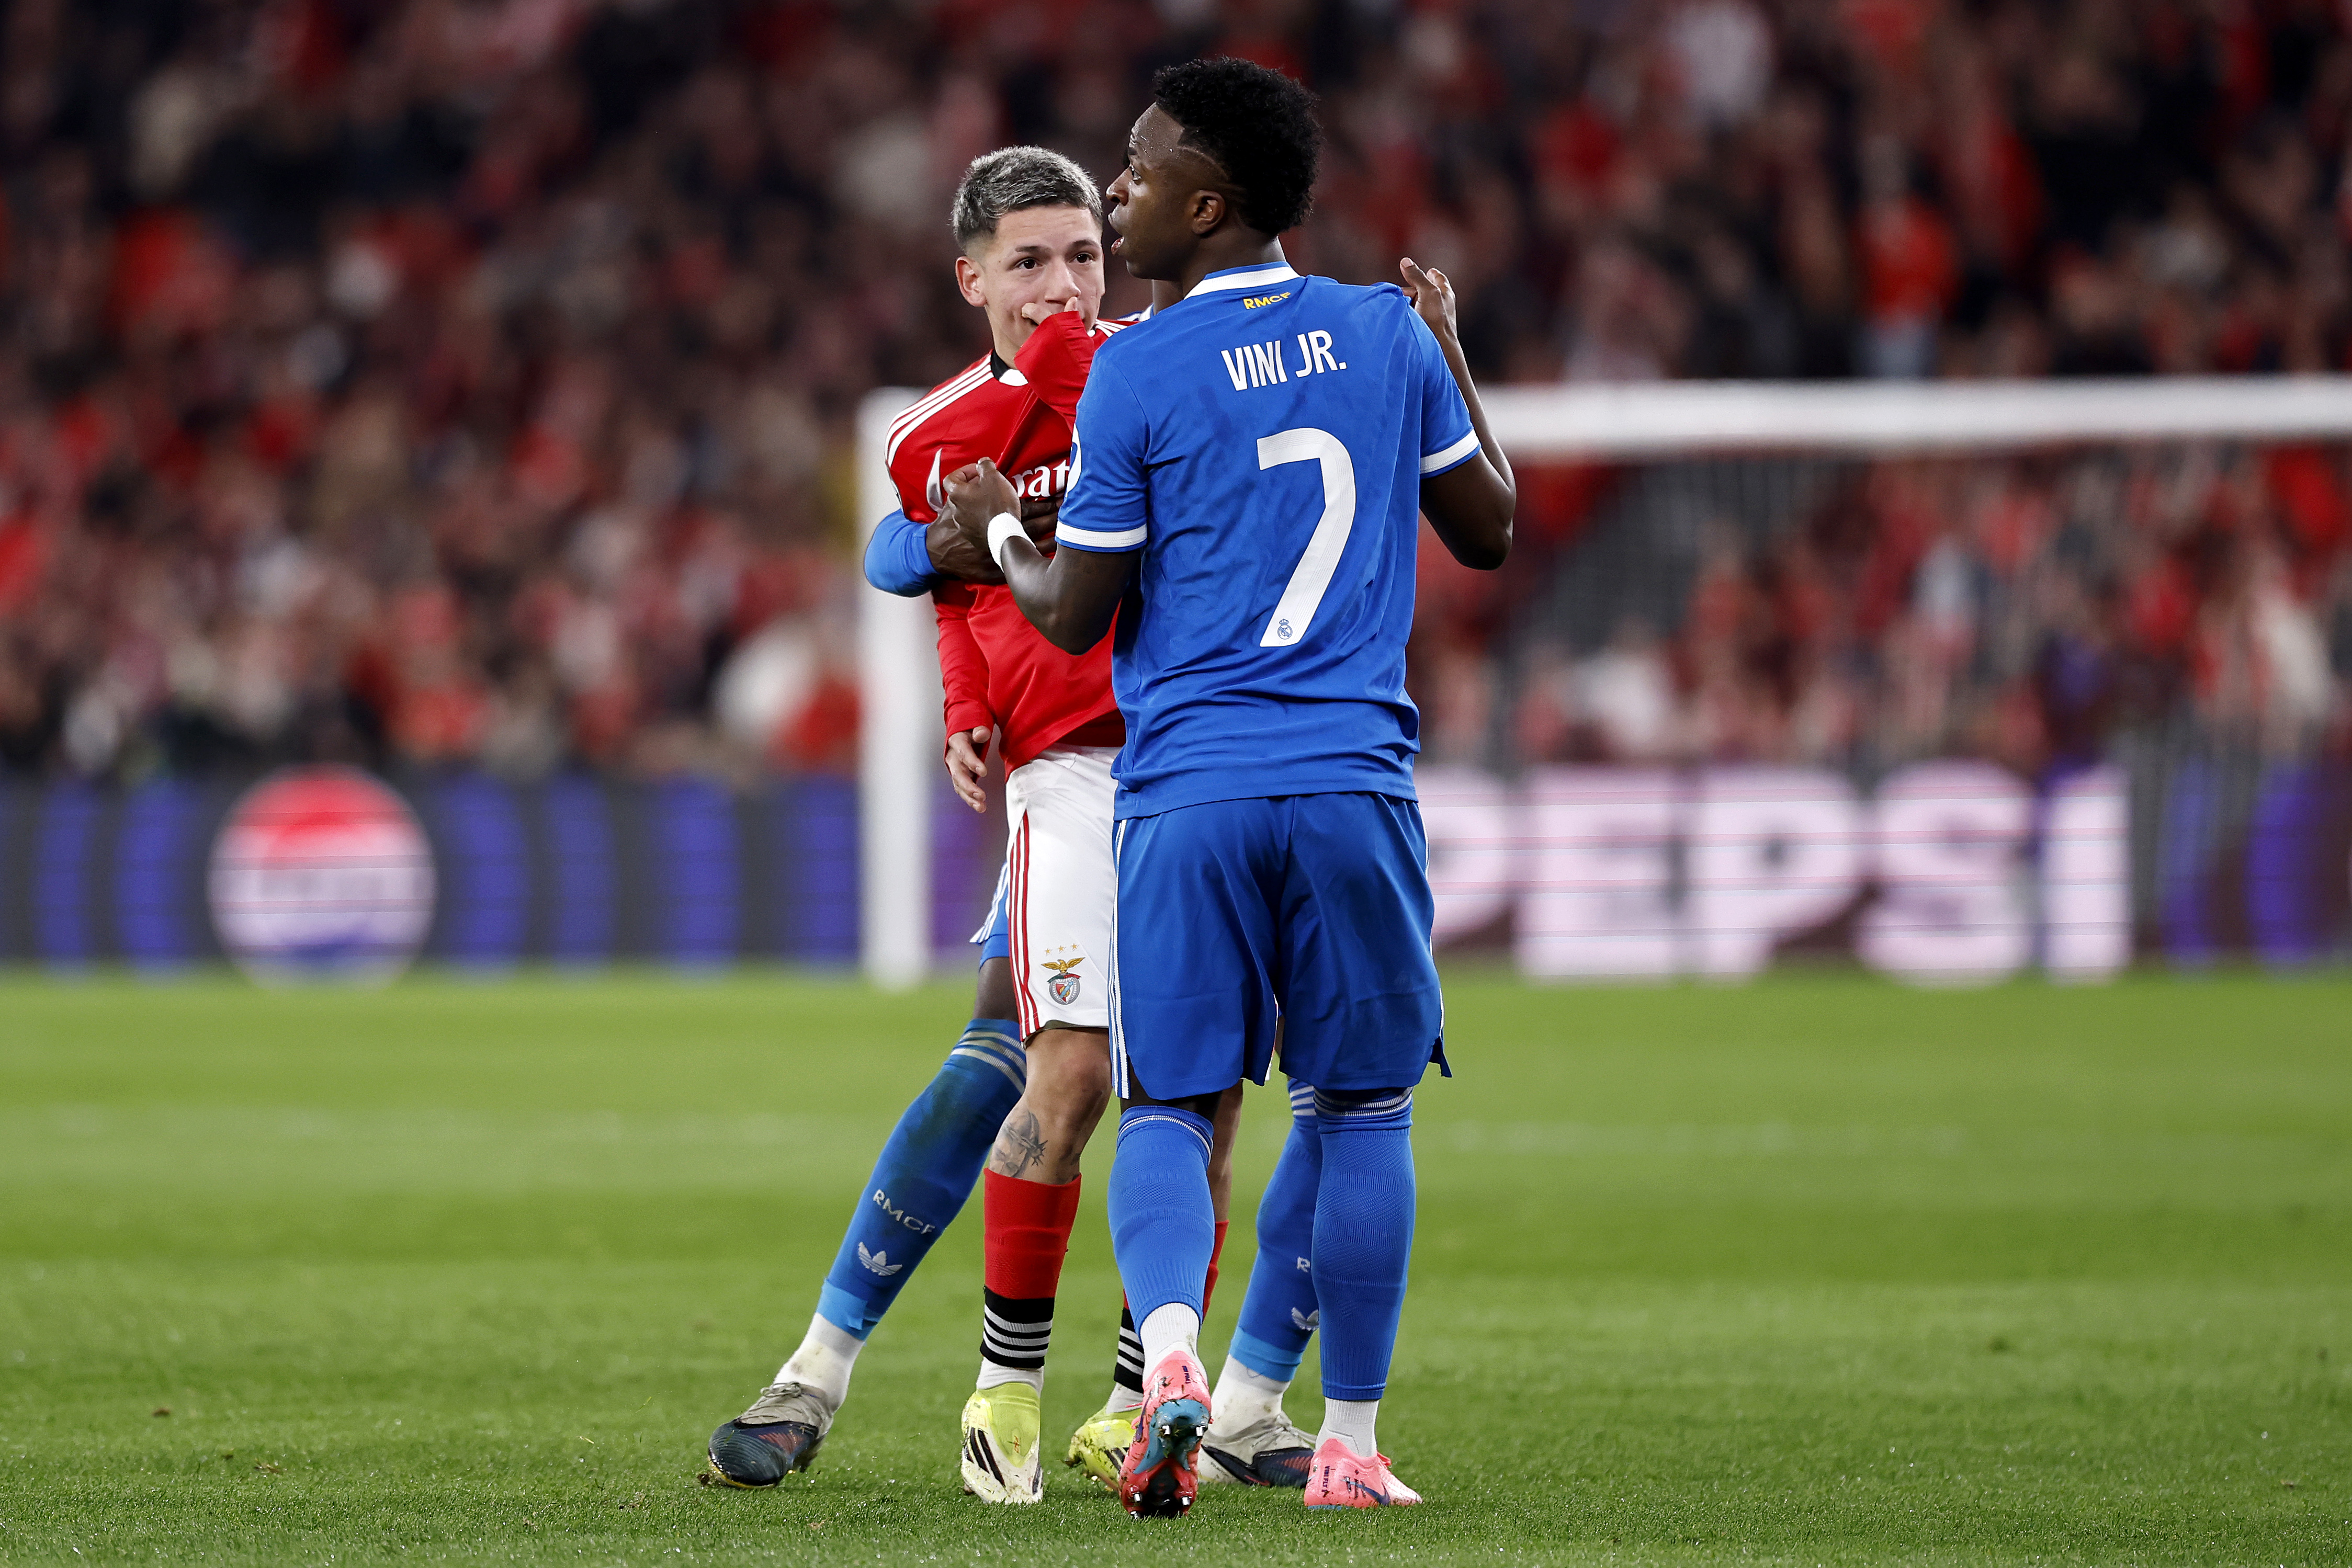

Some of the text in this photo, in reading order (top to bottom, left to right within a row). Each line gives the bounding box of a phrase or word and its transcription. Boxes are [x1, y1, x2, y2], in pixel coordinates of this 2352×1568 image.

[1243, 292, 1292, 310] RMCF
[1220, 330, 1348, 391] VINI JR.
[1257, 427, 1356, 647] 7
